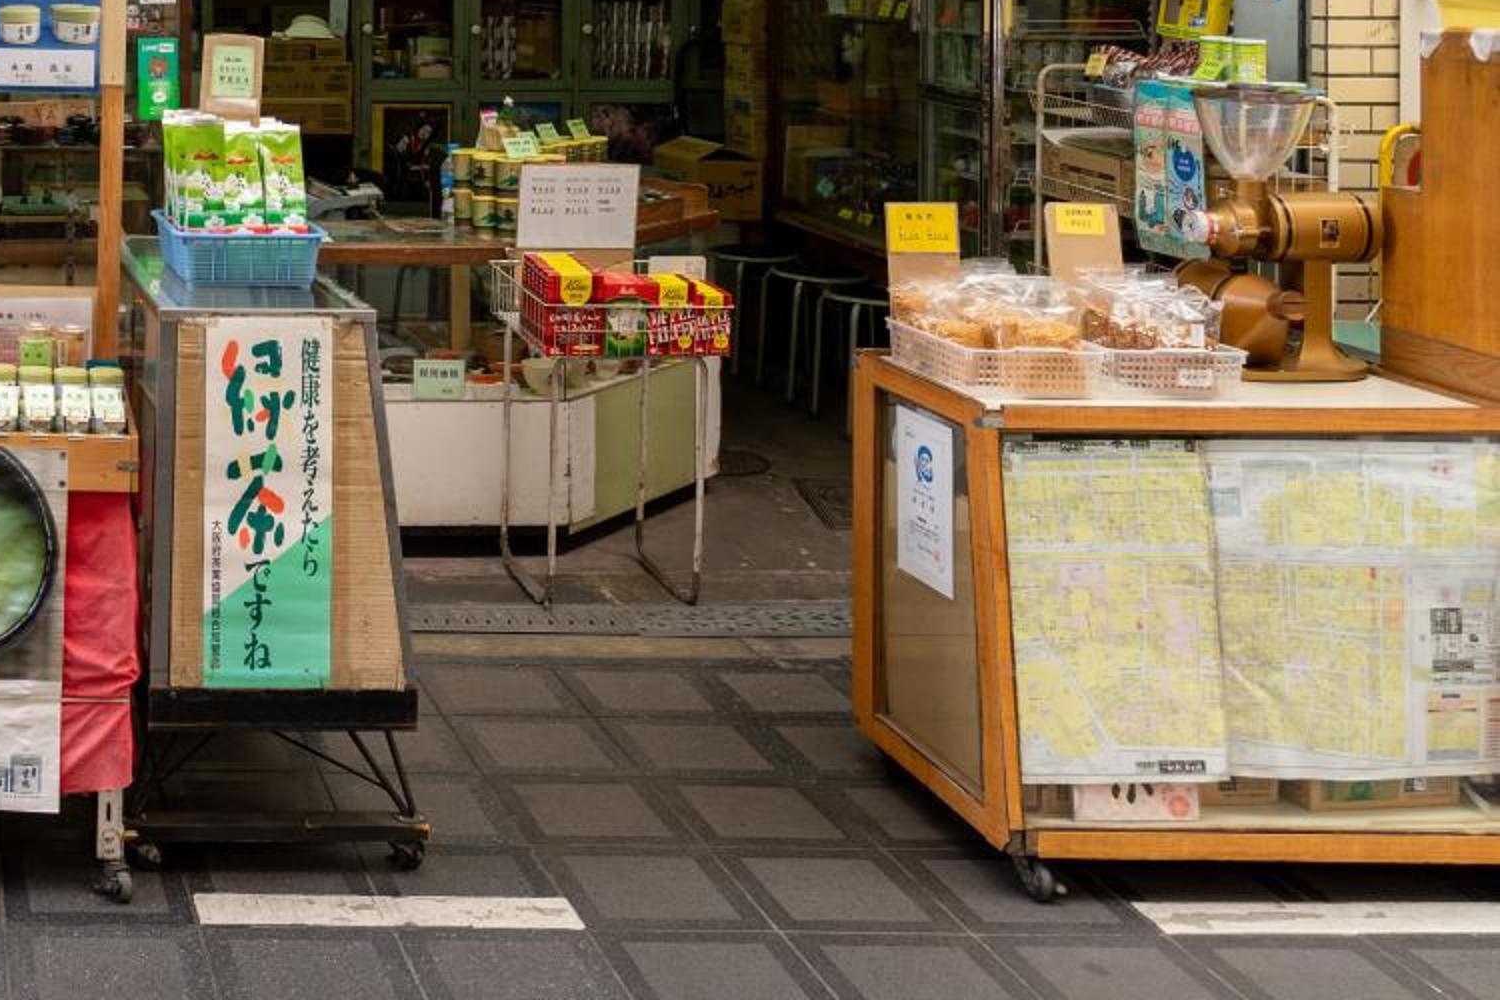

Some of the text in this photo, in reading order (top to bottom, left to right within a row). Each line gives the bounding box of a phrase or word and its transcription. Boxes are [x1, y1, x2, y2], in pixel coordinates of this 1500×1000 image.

[301, 338, 322, 578] 健康を考えたら
